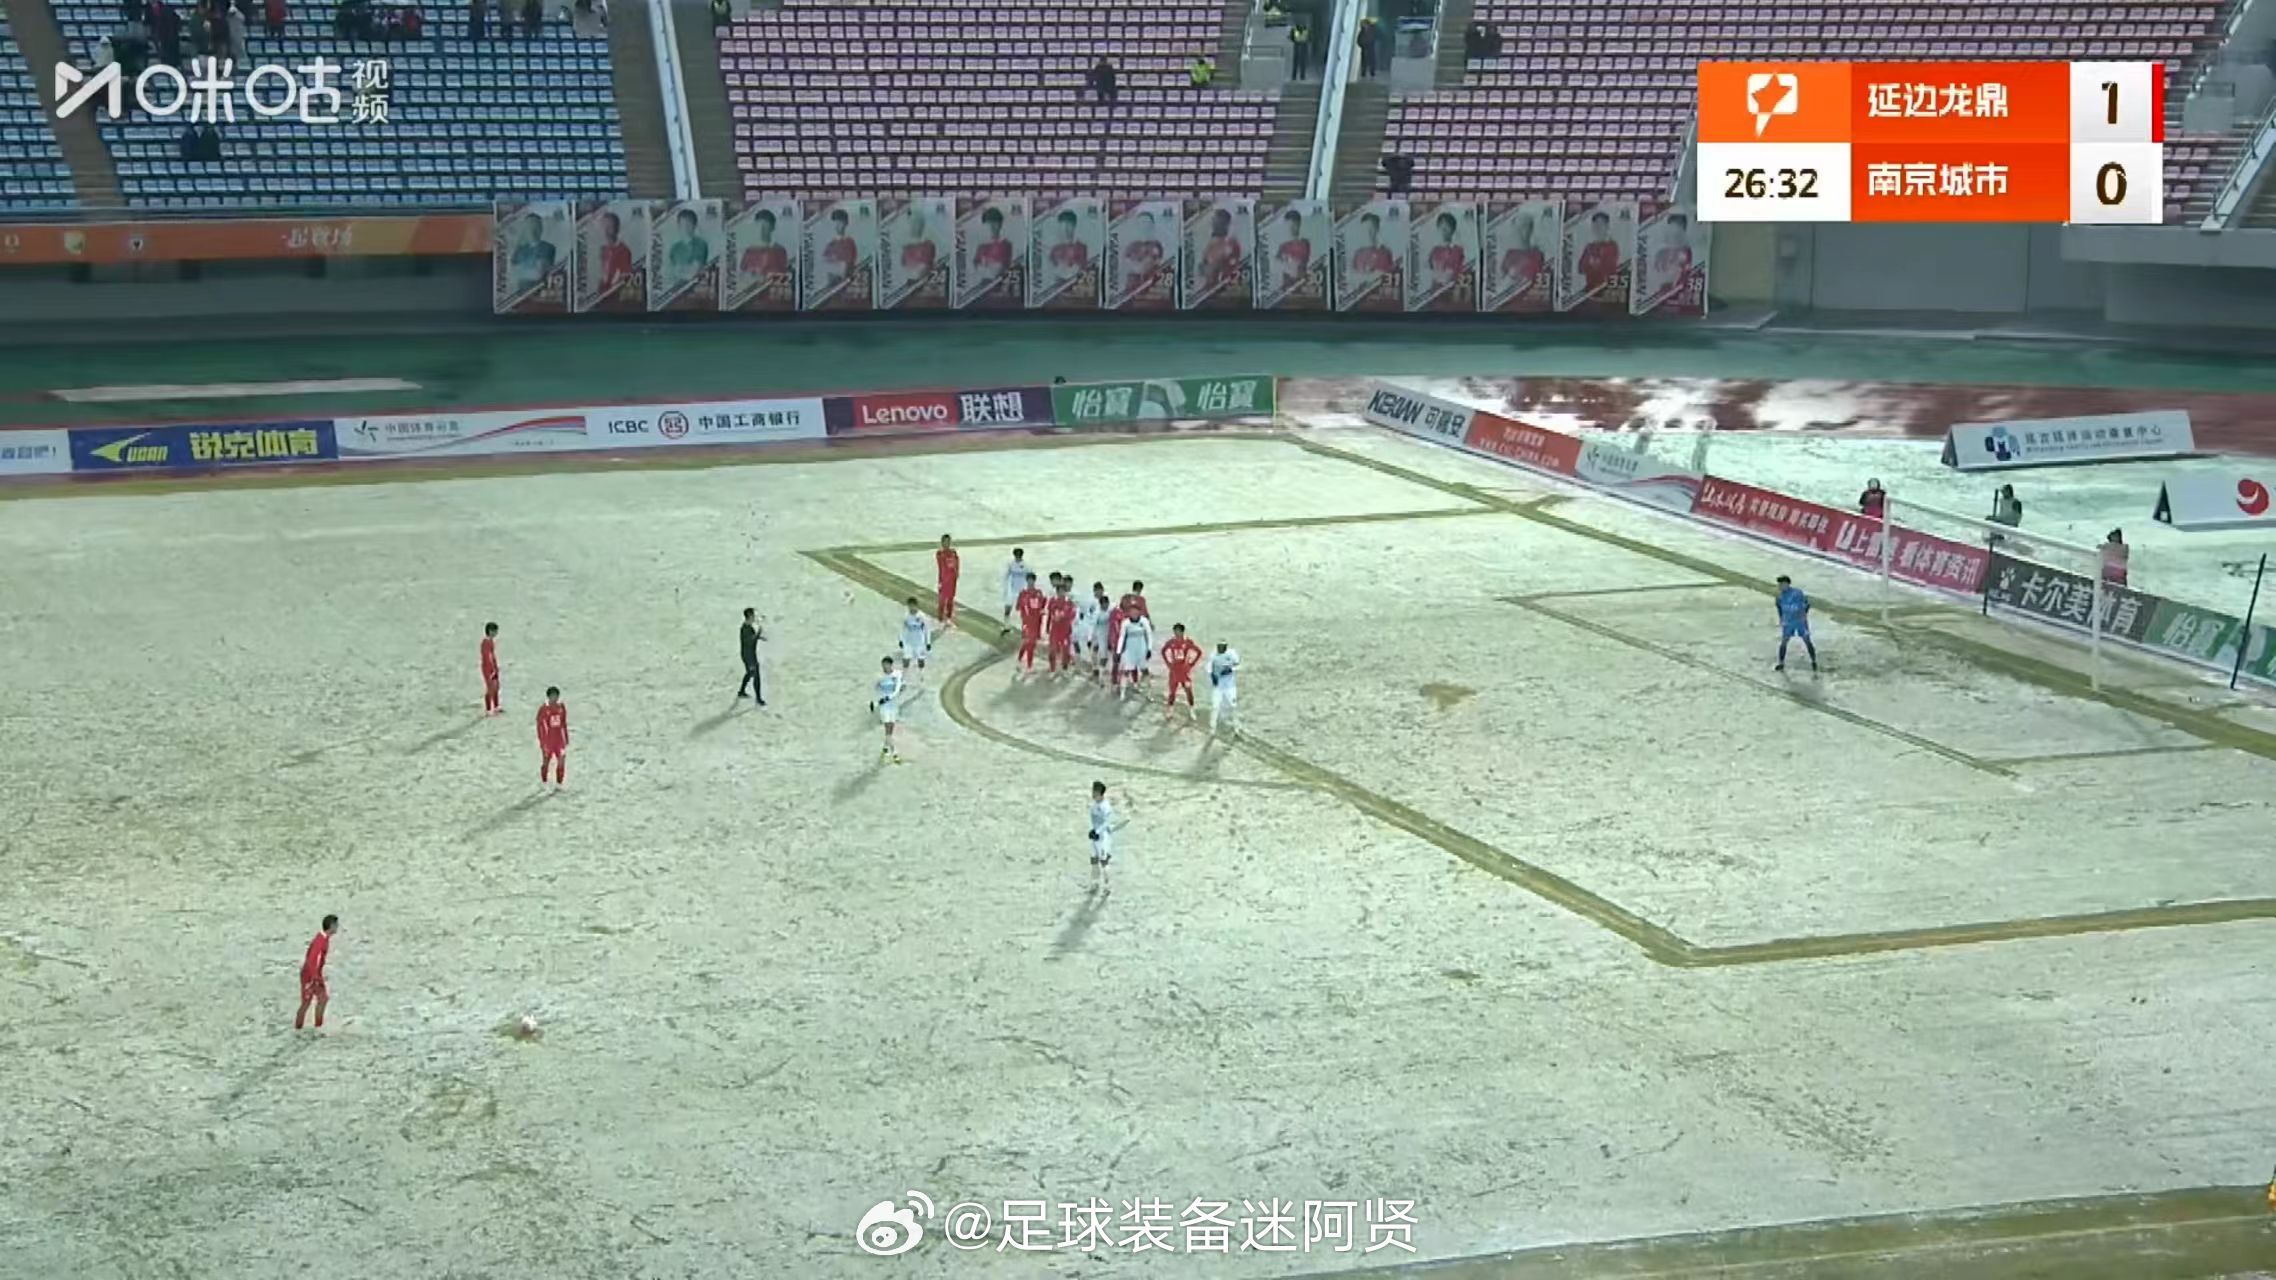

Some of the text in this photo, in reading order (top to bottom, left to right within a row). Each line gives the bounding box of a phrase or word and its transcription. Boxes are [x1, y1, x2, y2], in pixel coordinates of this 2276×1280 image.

[608, 411, 800, 434] ICBC 中国工商银行
[862, 392, 1024, 424] Lenovo 联想
[188, 428, 319, 460] 锐克体育
